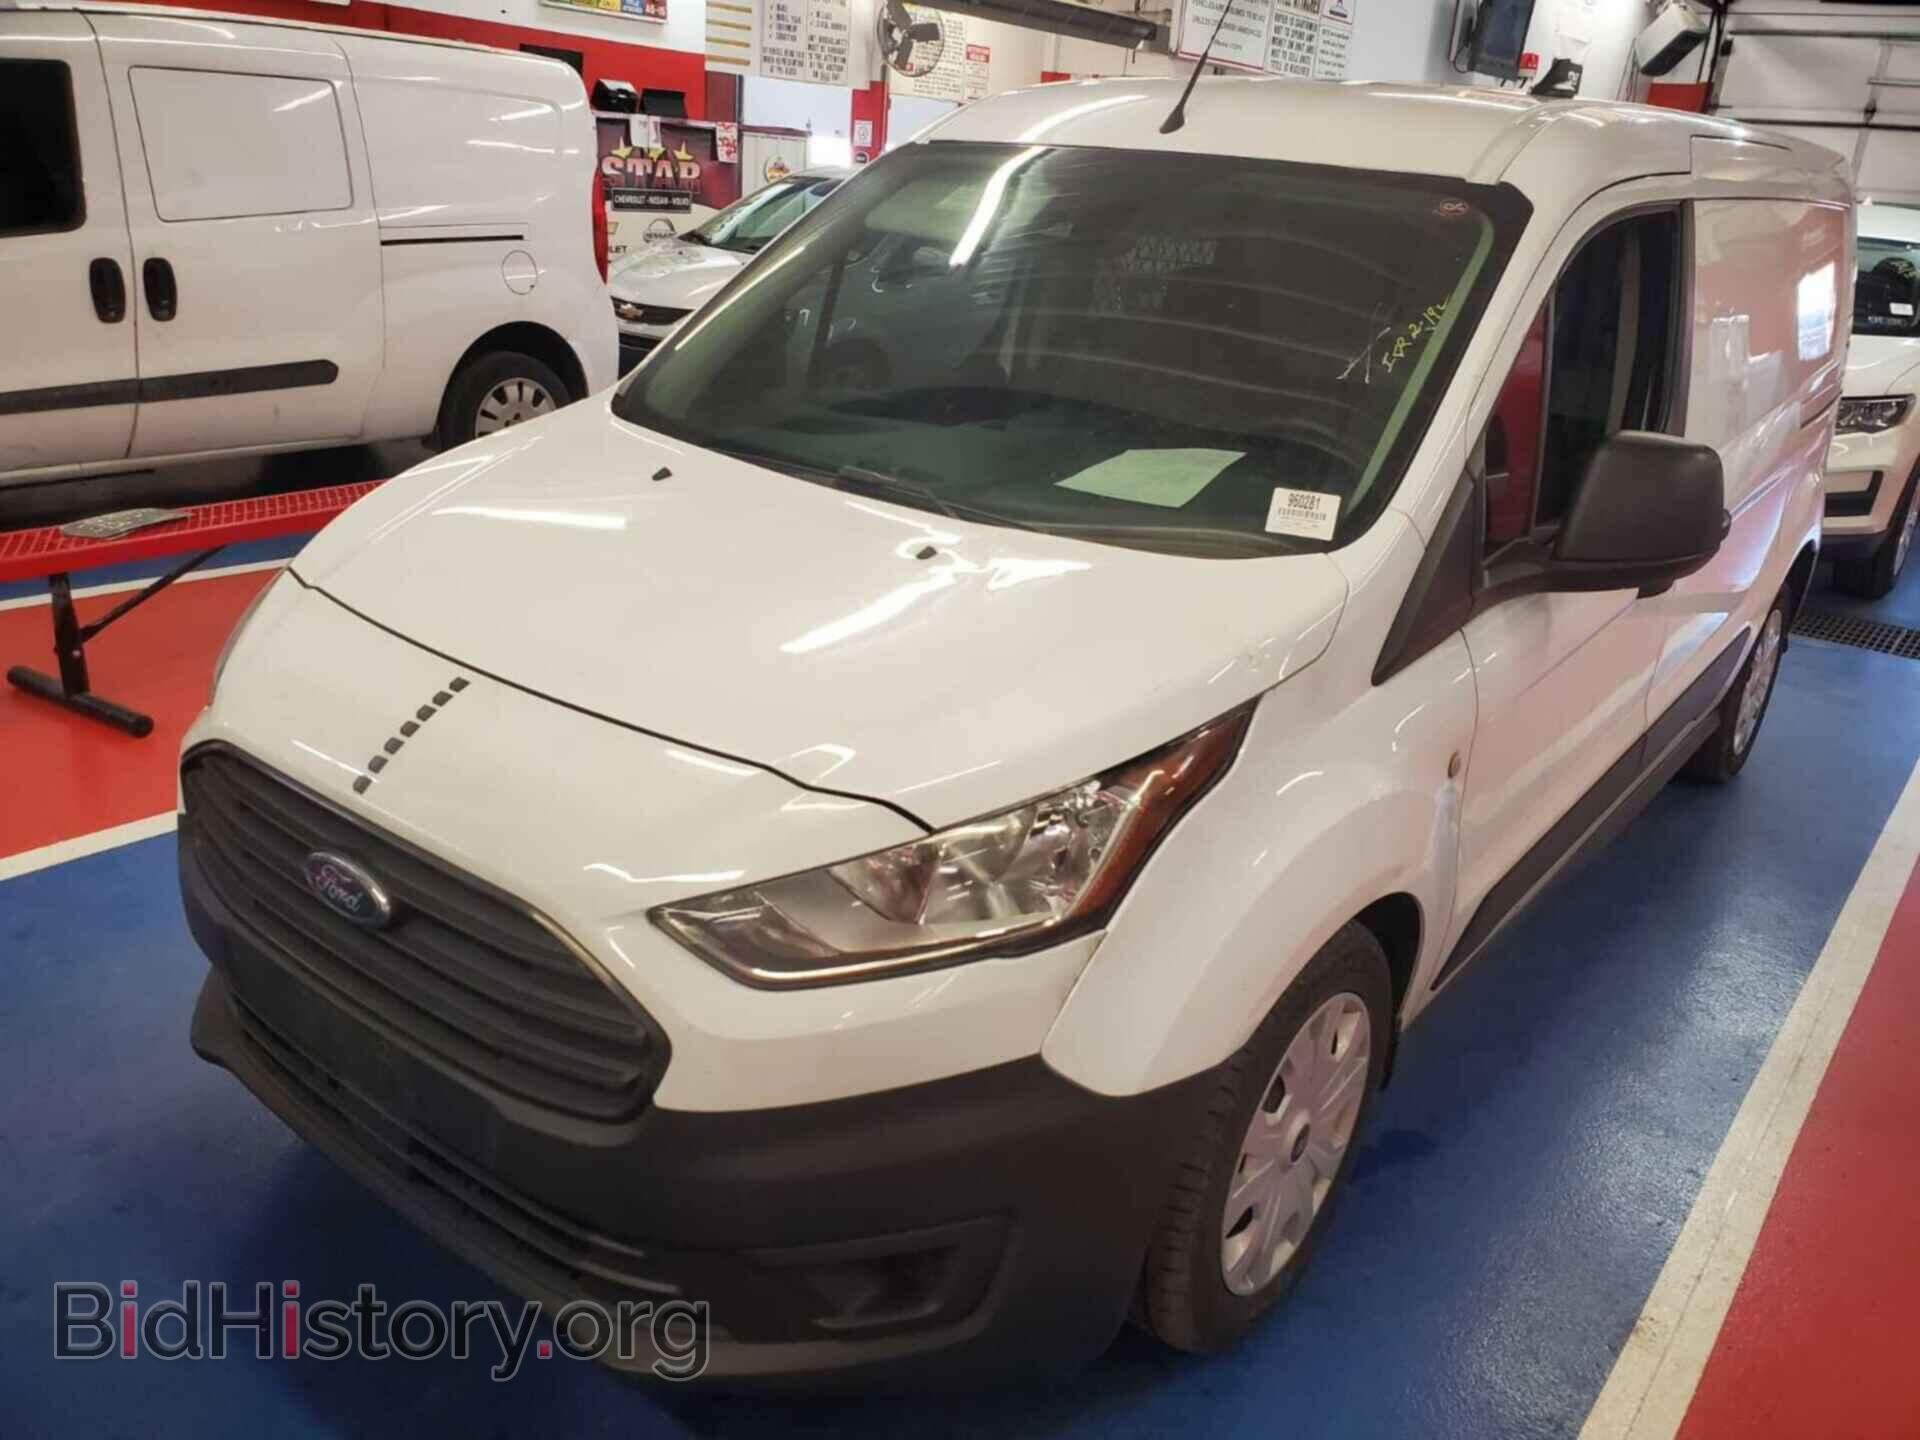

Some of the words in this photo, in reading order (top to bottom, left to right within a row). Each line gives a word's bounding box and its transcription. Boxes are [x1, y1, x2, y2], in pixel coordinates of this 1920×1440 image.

[601, 156, 704, 193] STAR
[614, 194, 646, 204] CHEVROLET
[649, 196, 669, 204] NISSAN
[672, 197, 690, 206] VOLVO
[313, 863, 363, 913] Ford
